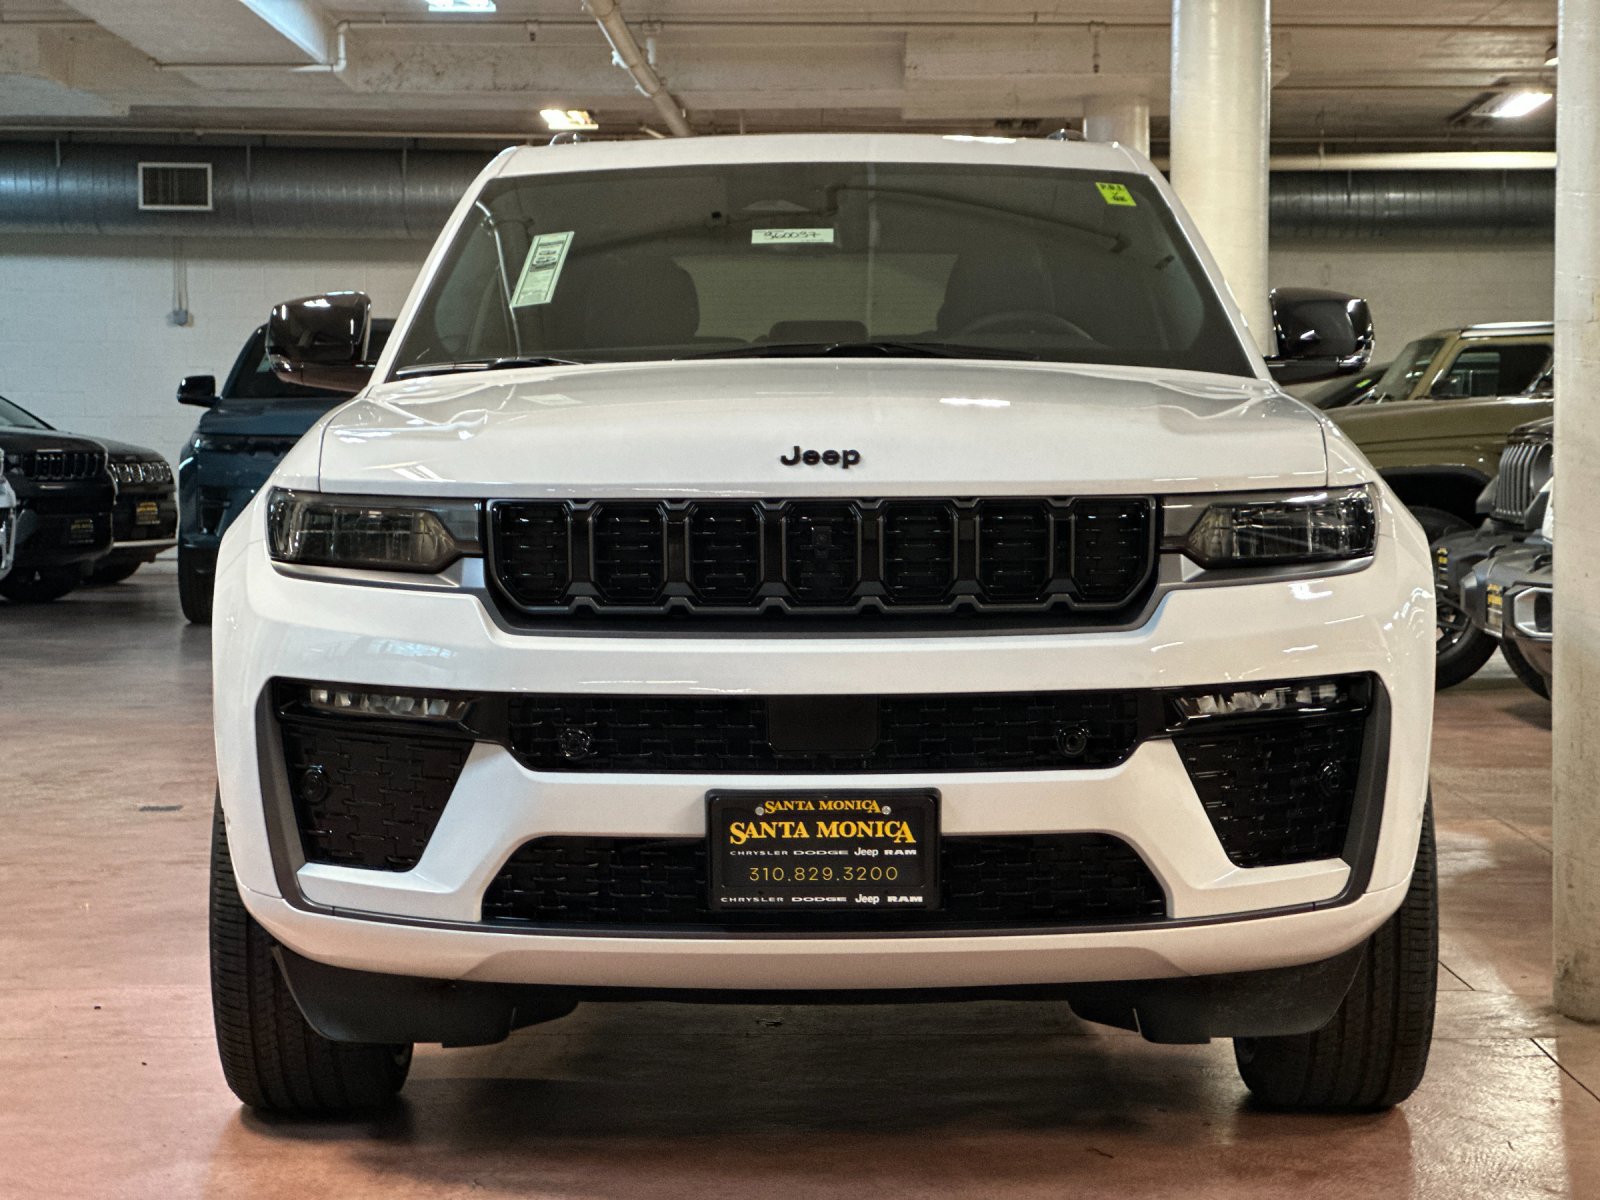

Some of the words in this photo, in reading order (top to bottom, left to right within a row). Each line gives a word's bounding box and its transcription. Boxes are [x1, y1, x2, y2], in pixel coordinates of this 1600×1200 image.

[781, 446, 860, 469] Jeep
[765, 801, 814, 813] SANTA
[819, 800, 881, 813] MONICA
[730, 822, 809, 844] SANTA
[816, 821, 916, 843] MONICA
[853, 846, 879, 858] Jeep
[750, 867, 897, 881] 310.829.3200
[854, 893, 881, 905] Jeep
[887, 895, 924, 903] RAM
